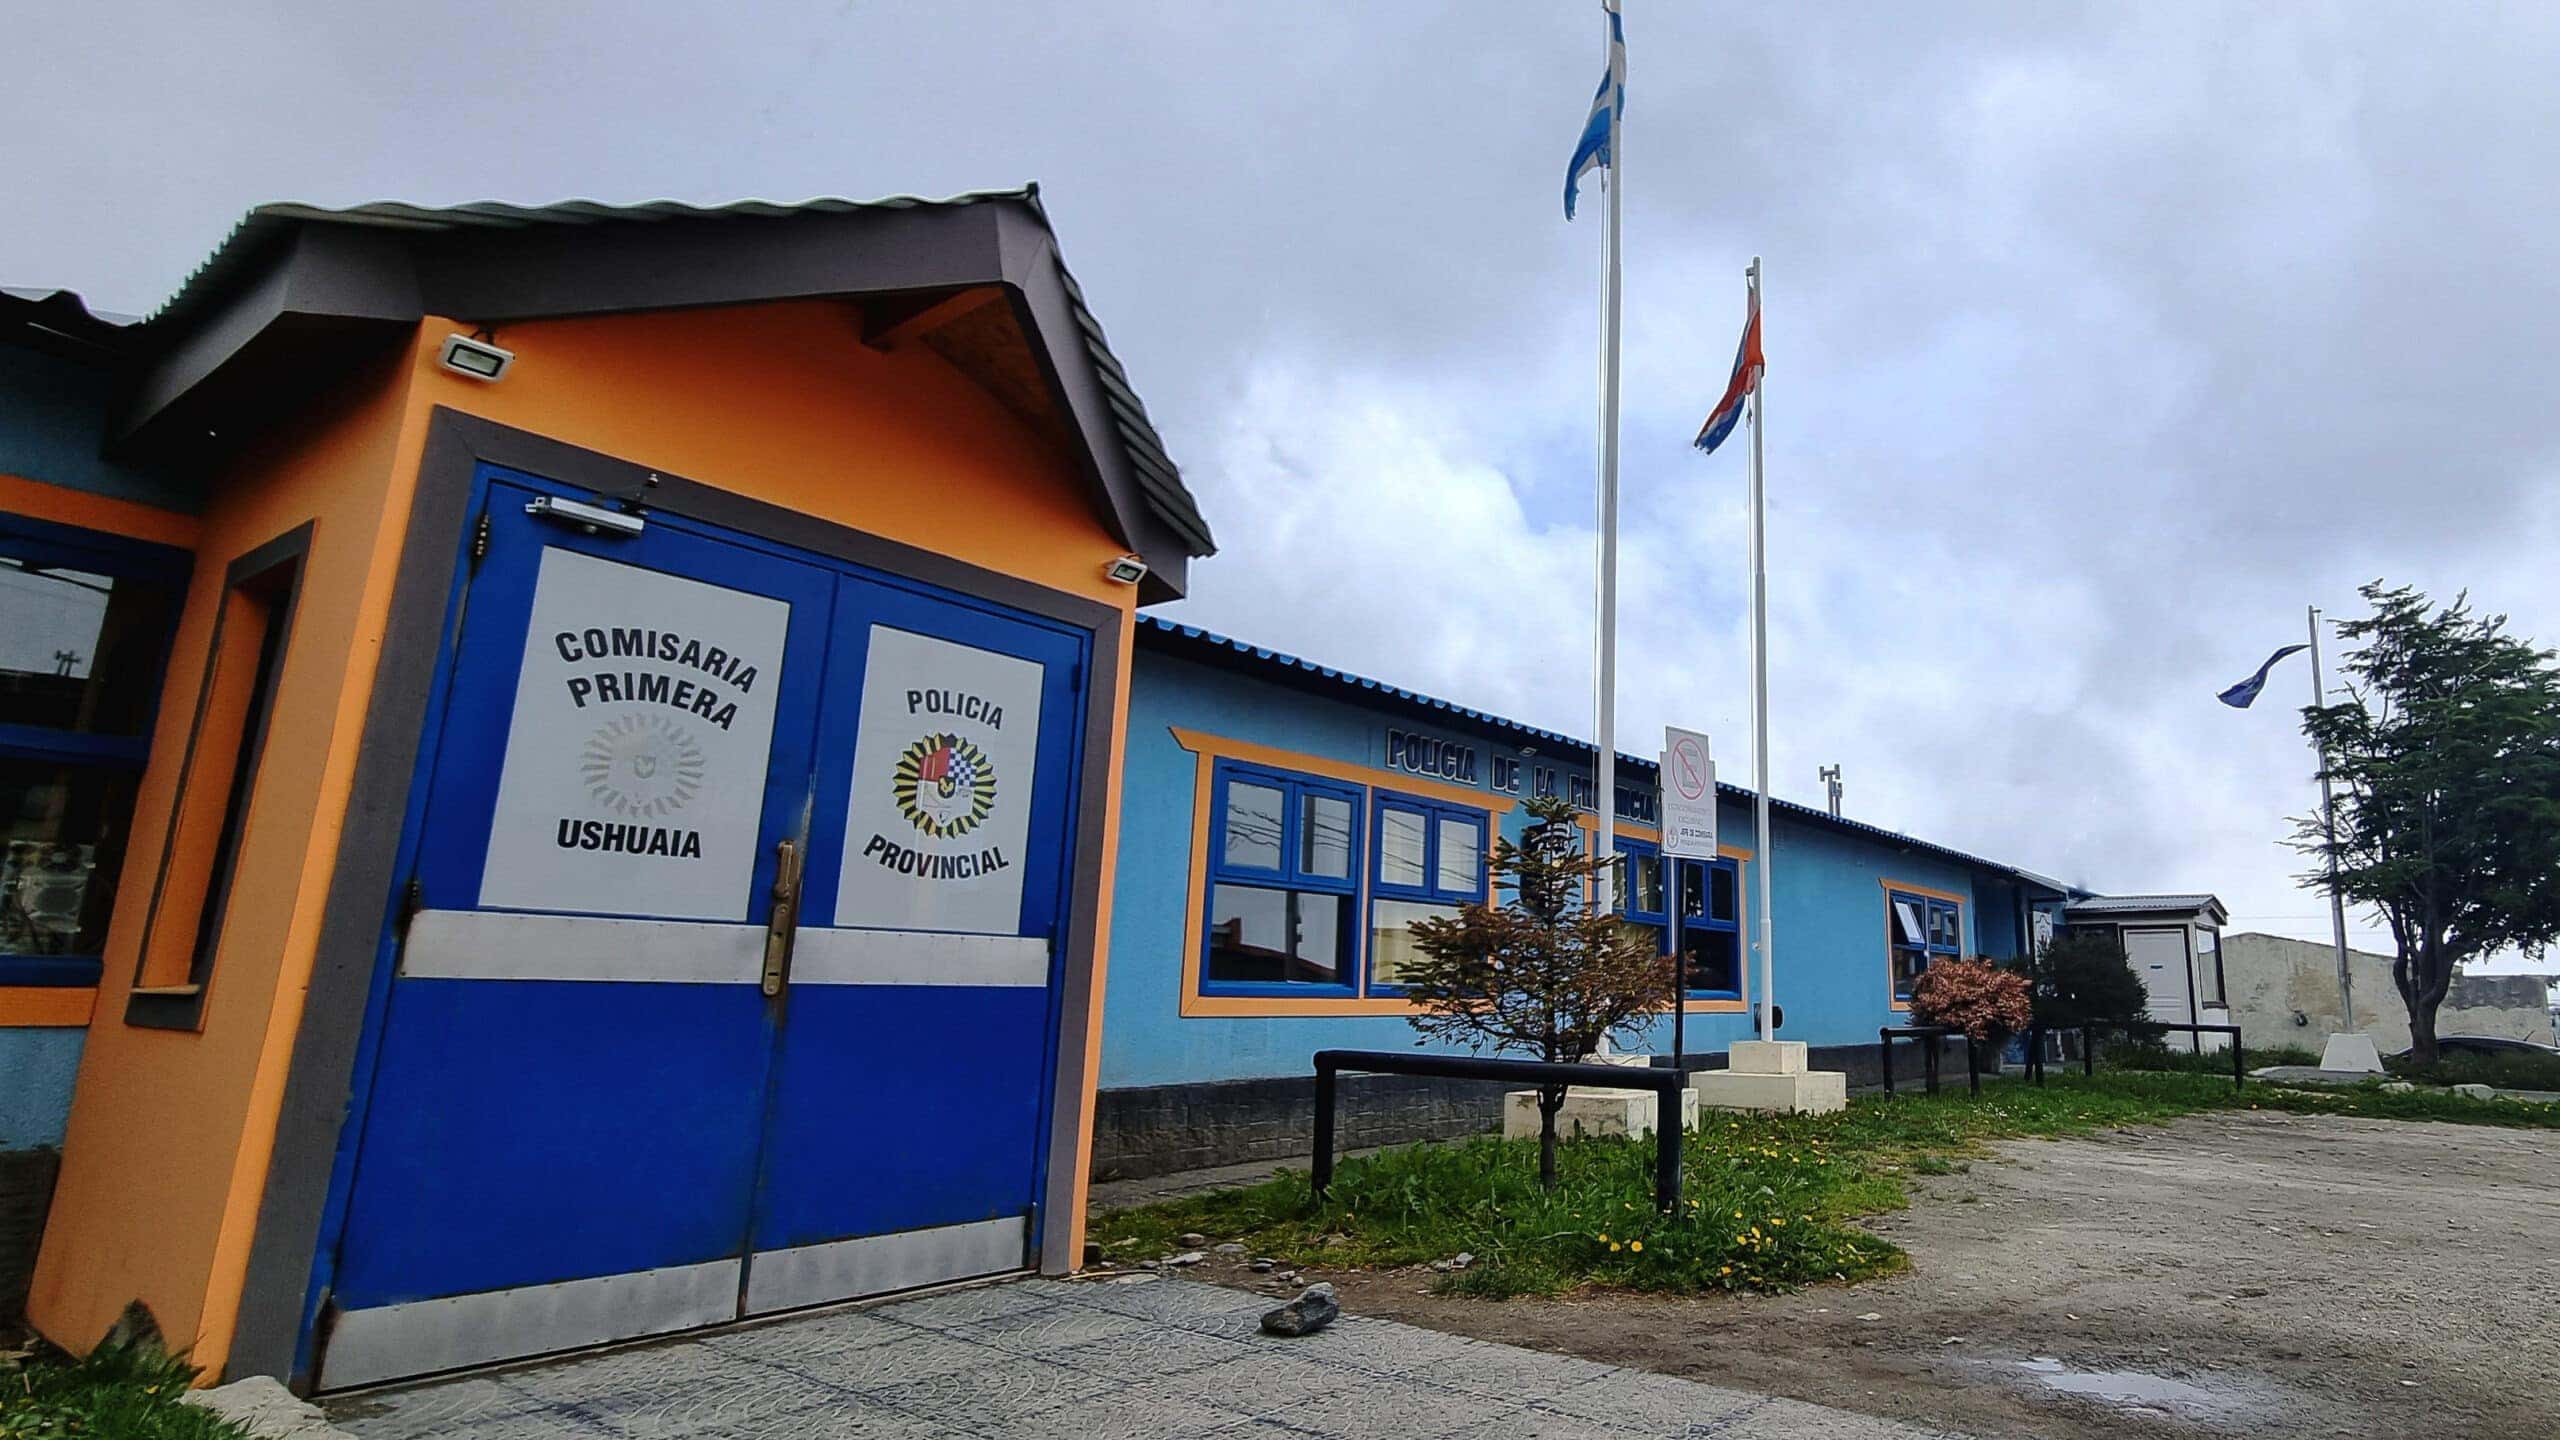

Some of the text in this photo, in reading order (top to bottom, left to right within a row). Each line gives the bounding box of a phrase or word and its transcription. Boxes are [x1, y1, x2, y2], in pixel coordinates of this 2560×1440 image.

[555, 627, 758, 694] COMISARIA
[566, 672, 738, 731] PRIMERA
[906, 689, 1003, 730] POLICIA
[1386, 727, 1479, 785] POLICIA
[1490, 753, 1521, 794] DE
[1533, 765, 1556, 800] LA
[557, 818, 701, 859] USHUAIA
[863, 833, 1010, 880] PROVINCIAL
